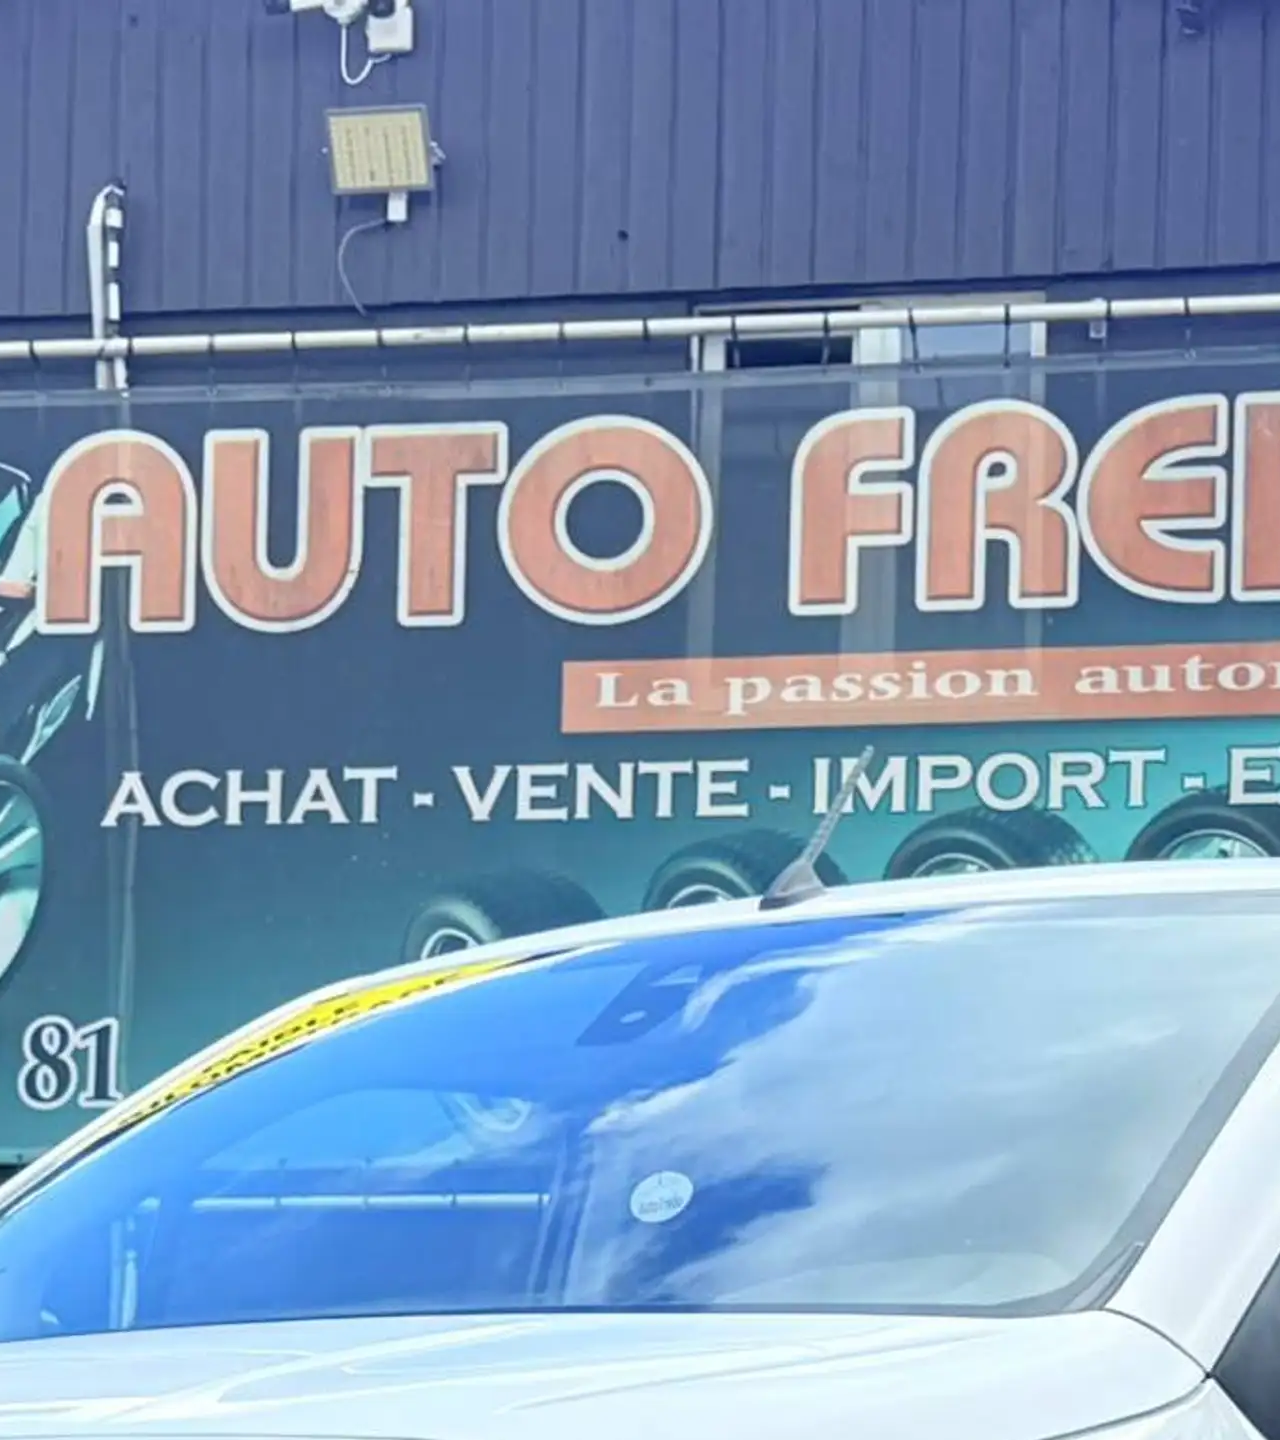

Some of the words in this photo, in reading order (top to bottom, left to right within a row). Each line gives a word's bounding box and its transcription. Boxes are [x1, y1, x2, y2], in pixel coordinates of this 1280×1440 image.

[36, 415, 712, 633] AUTO
[593, 669, 693, 708] La
[724, 658, 1039, 715] passion
[100, 765, 398, 828] ACHAT
[451, 758, 750, 822] VENTE
[812, 747, 1167, 815] IMPORT
[18, 1014, 124, 1110] 81
